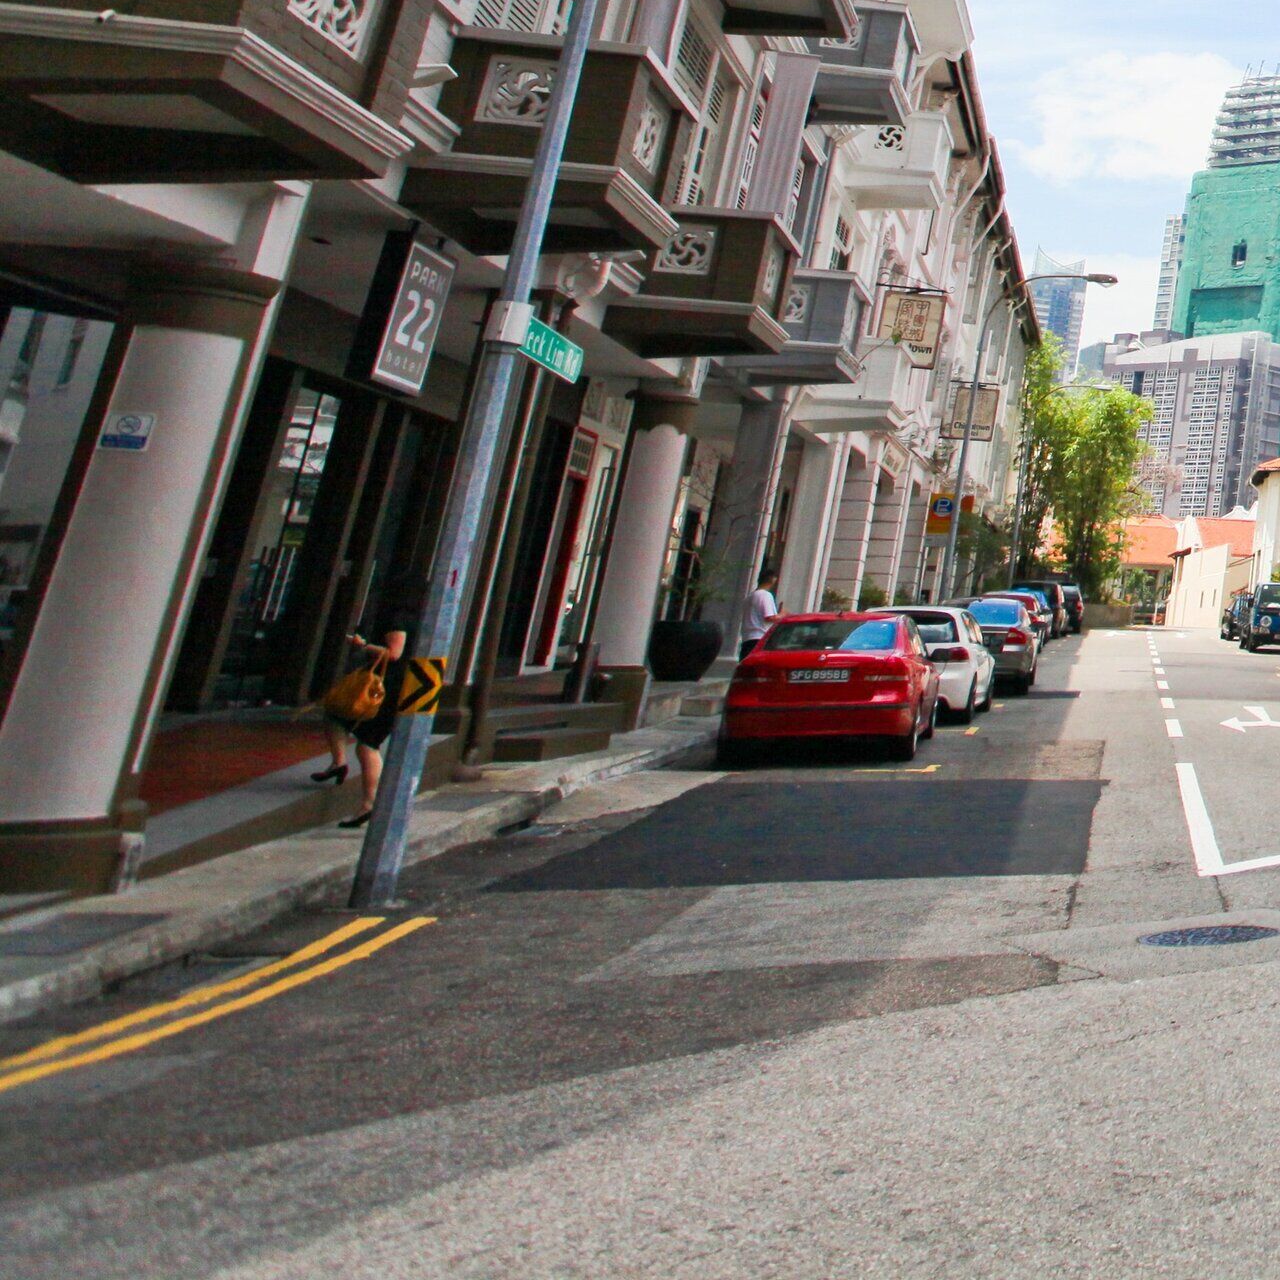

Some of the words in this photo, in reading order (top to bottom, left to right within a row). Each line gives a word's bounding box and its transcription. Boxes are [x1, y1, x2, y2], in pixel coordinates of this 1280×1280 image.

[410, 261, 447, 294] PARK
[394, 289, 436, 354] 22
[545, 336, 564, 369] Lim
[564, 347, 580, 377] Rd
